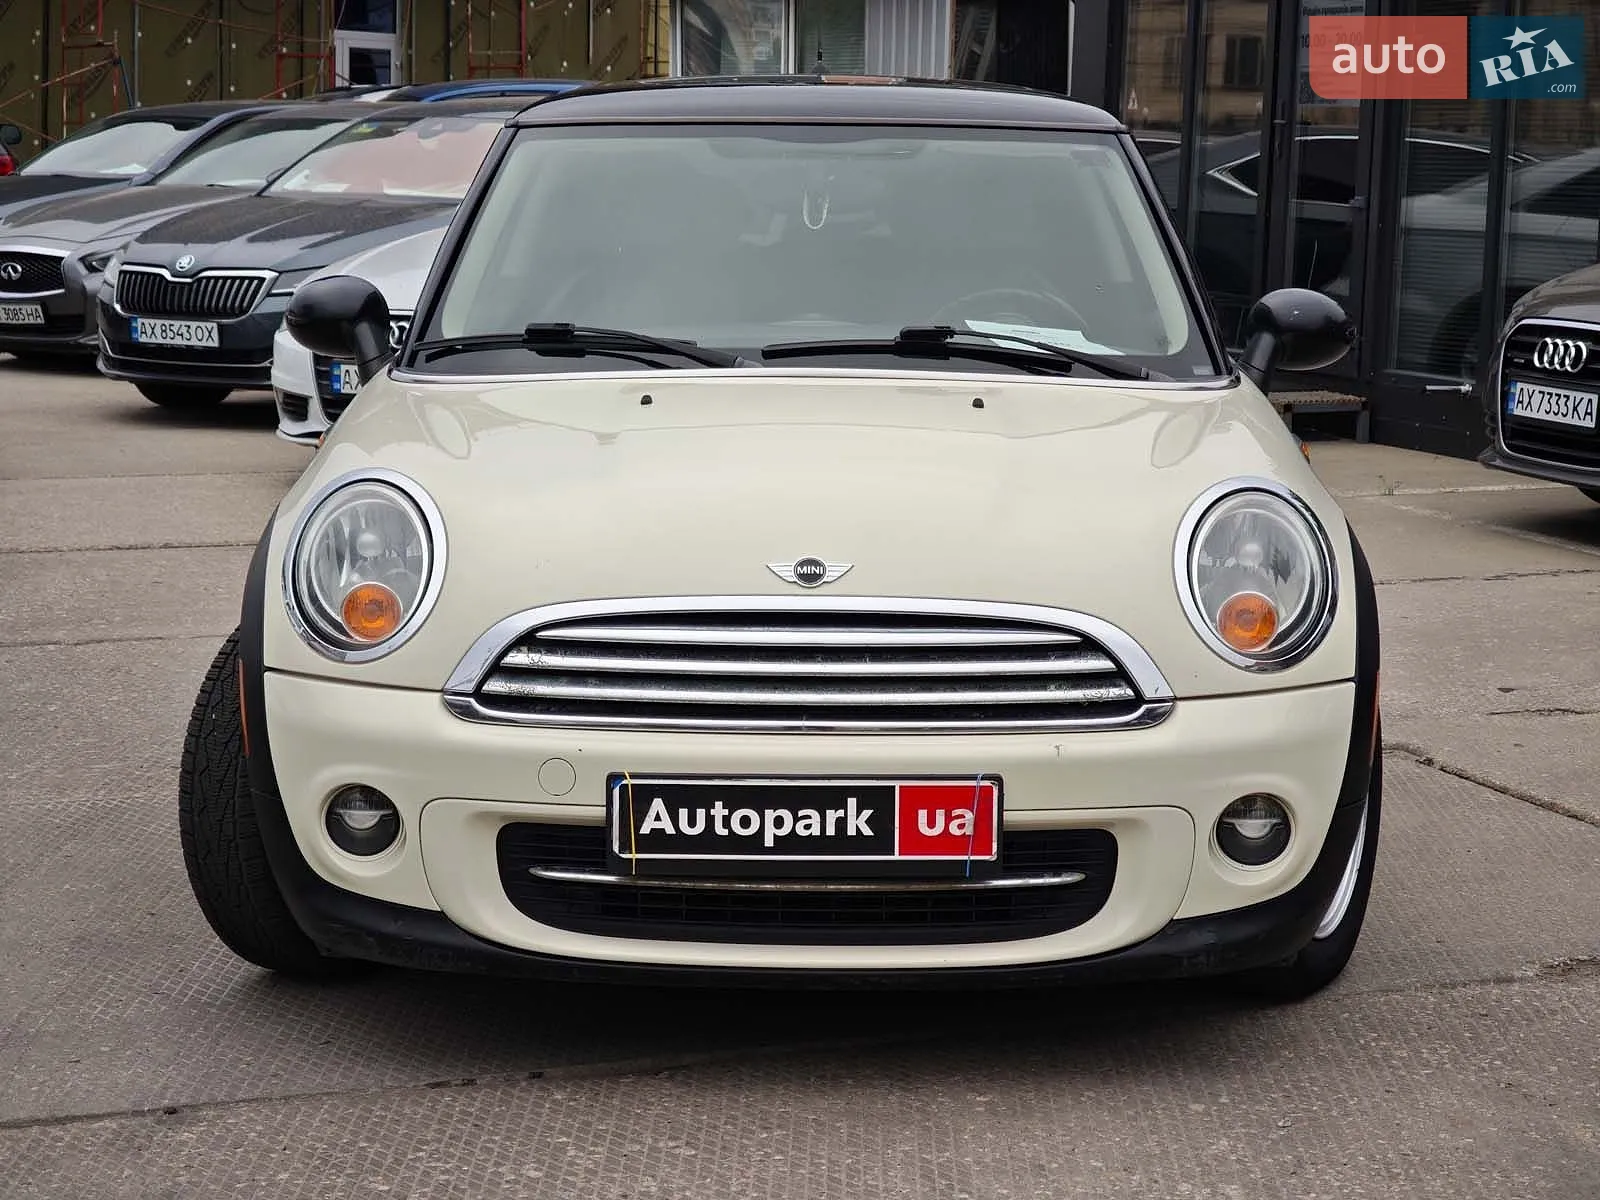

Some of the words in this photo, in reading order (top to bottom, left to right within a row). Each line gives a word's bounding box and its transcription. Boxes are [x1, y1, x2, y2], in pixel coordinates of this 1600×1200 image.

[26, 307, 43, 321] HA
[140, 322, 158, 339] AX
[160, 323, 192, 341] 8543
[195, 325, 215, 343] OX
[1516, 387, 1536, 412] AX
[1536, 390, 1570, 418] 7333
[1572, 395, 1593, 423] KA
[796, 565, 825, 575] MINI
[639, 797, 875, 847] Autopark
[916, 808, 974, 837] ua
